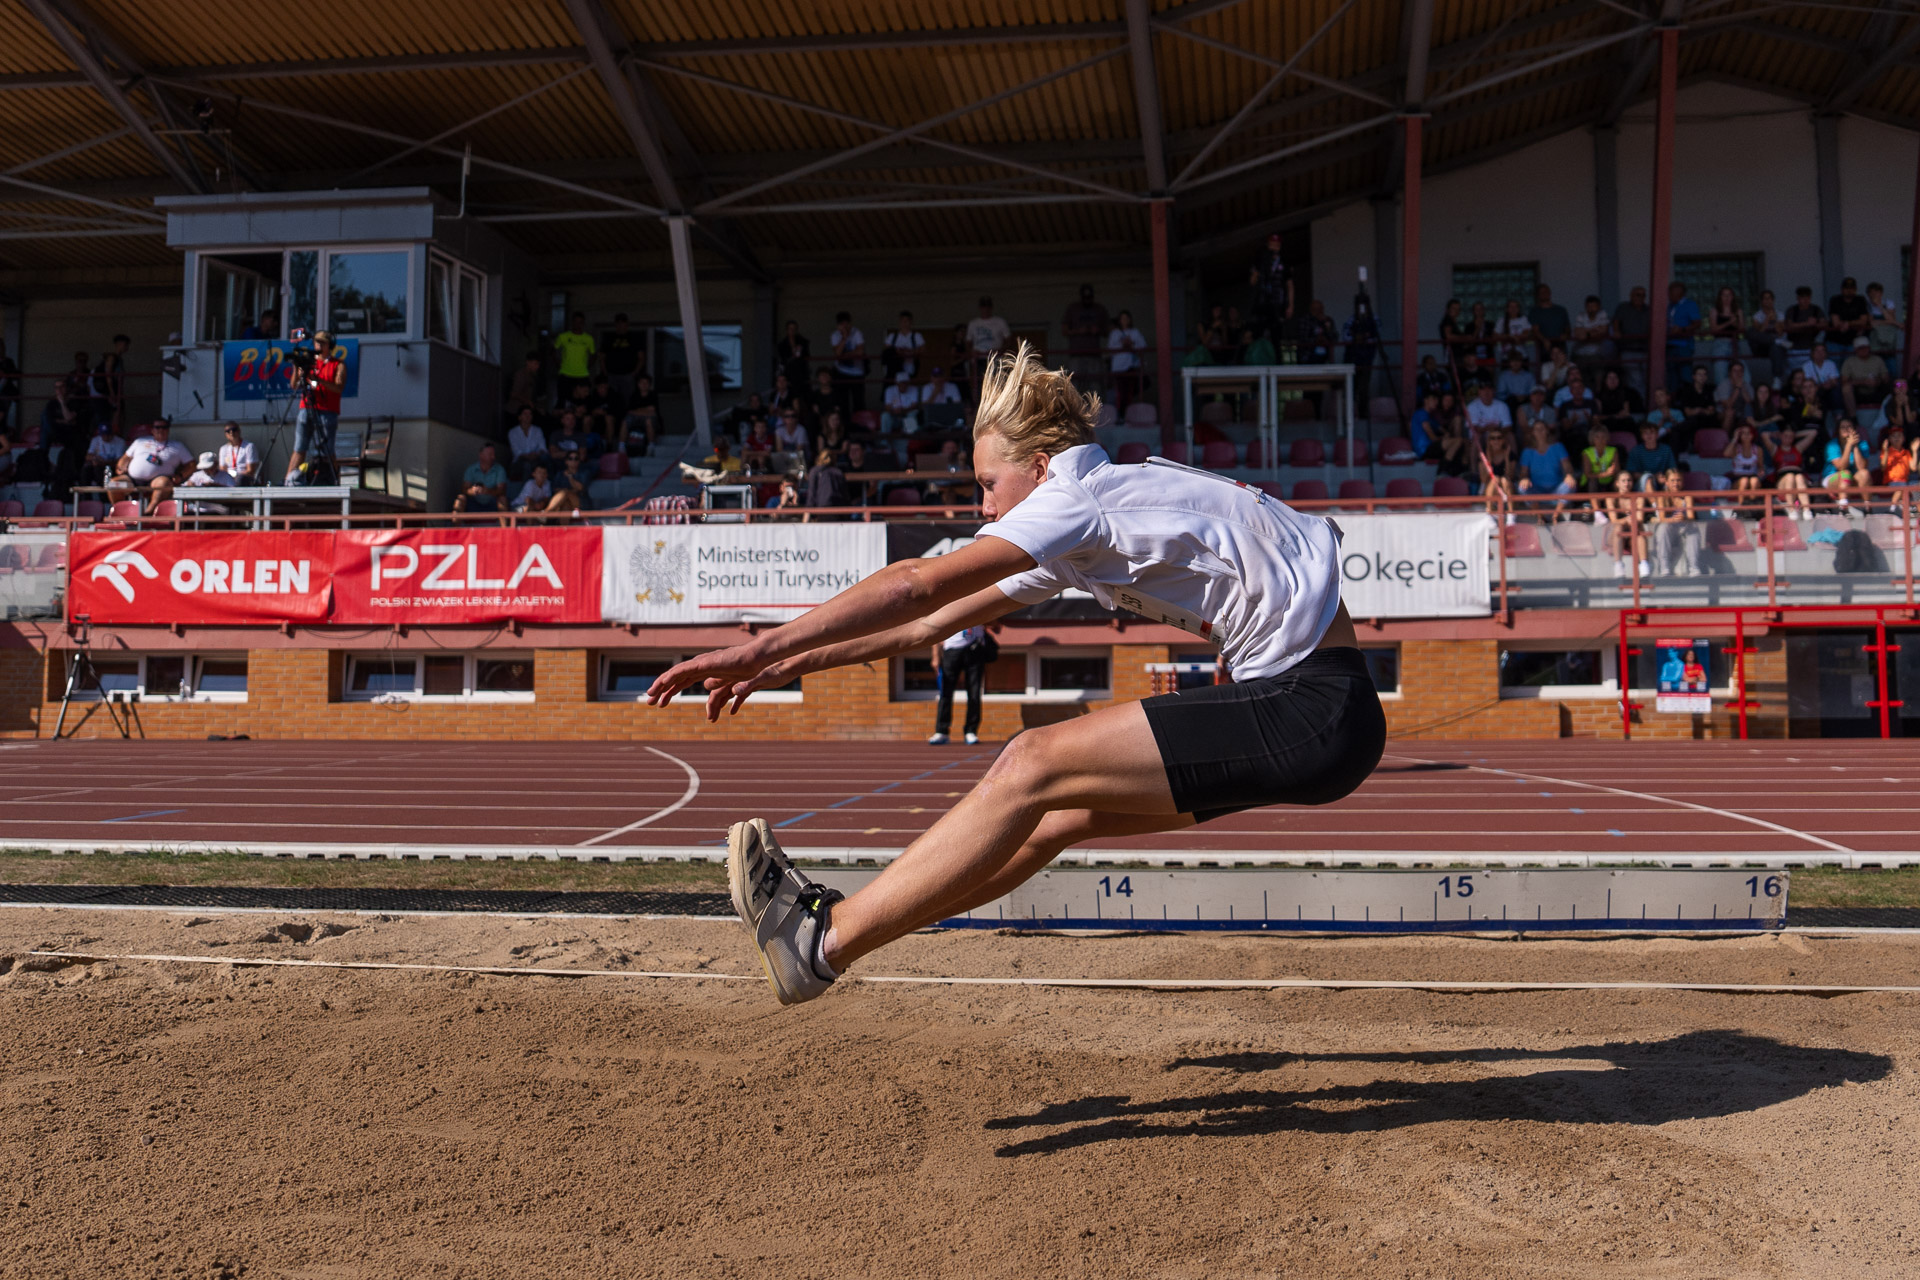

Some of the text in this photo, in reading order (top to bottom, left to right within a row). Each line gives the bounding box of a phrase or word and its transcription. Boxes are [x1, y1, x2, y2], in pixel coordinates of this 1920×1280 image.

[369, 543, 564, 590] PZLA
[697, 546, 820, 564] Ministerstwo
[169, 558, 311, 594] ORLEN
[697, 569, 860, 590] Sportu i Turystyki
[1342, 550, 1468, 588] Okęcie
[370, 596, 565, 608] POLSKI ZWIĄZEK LEKKIEJ ATLETYKI
[1098, 875, 1134, 898] 14
[1438, 875, 1474, 898] 15
[1745, 875, 1782, 898] 16
